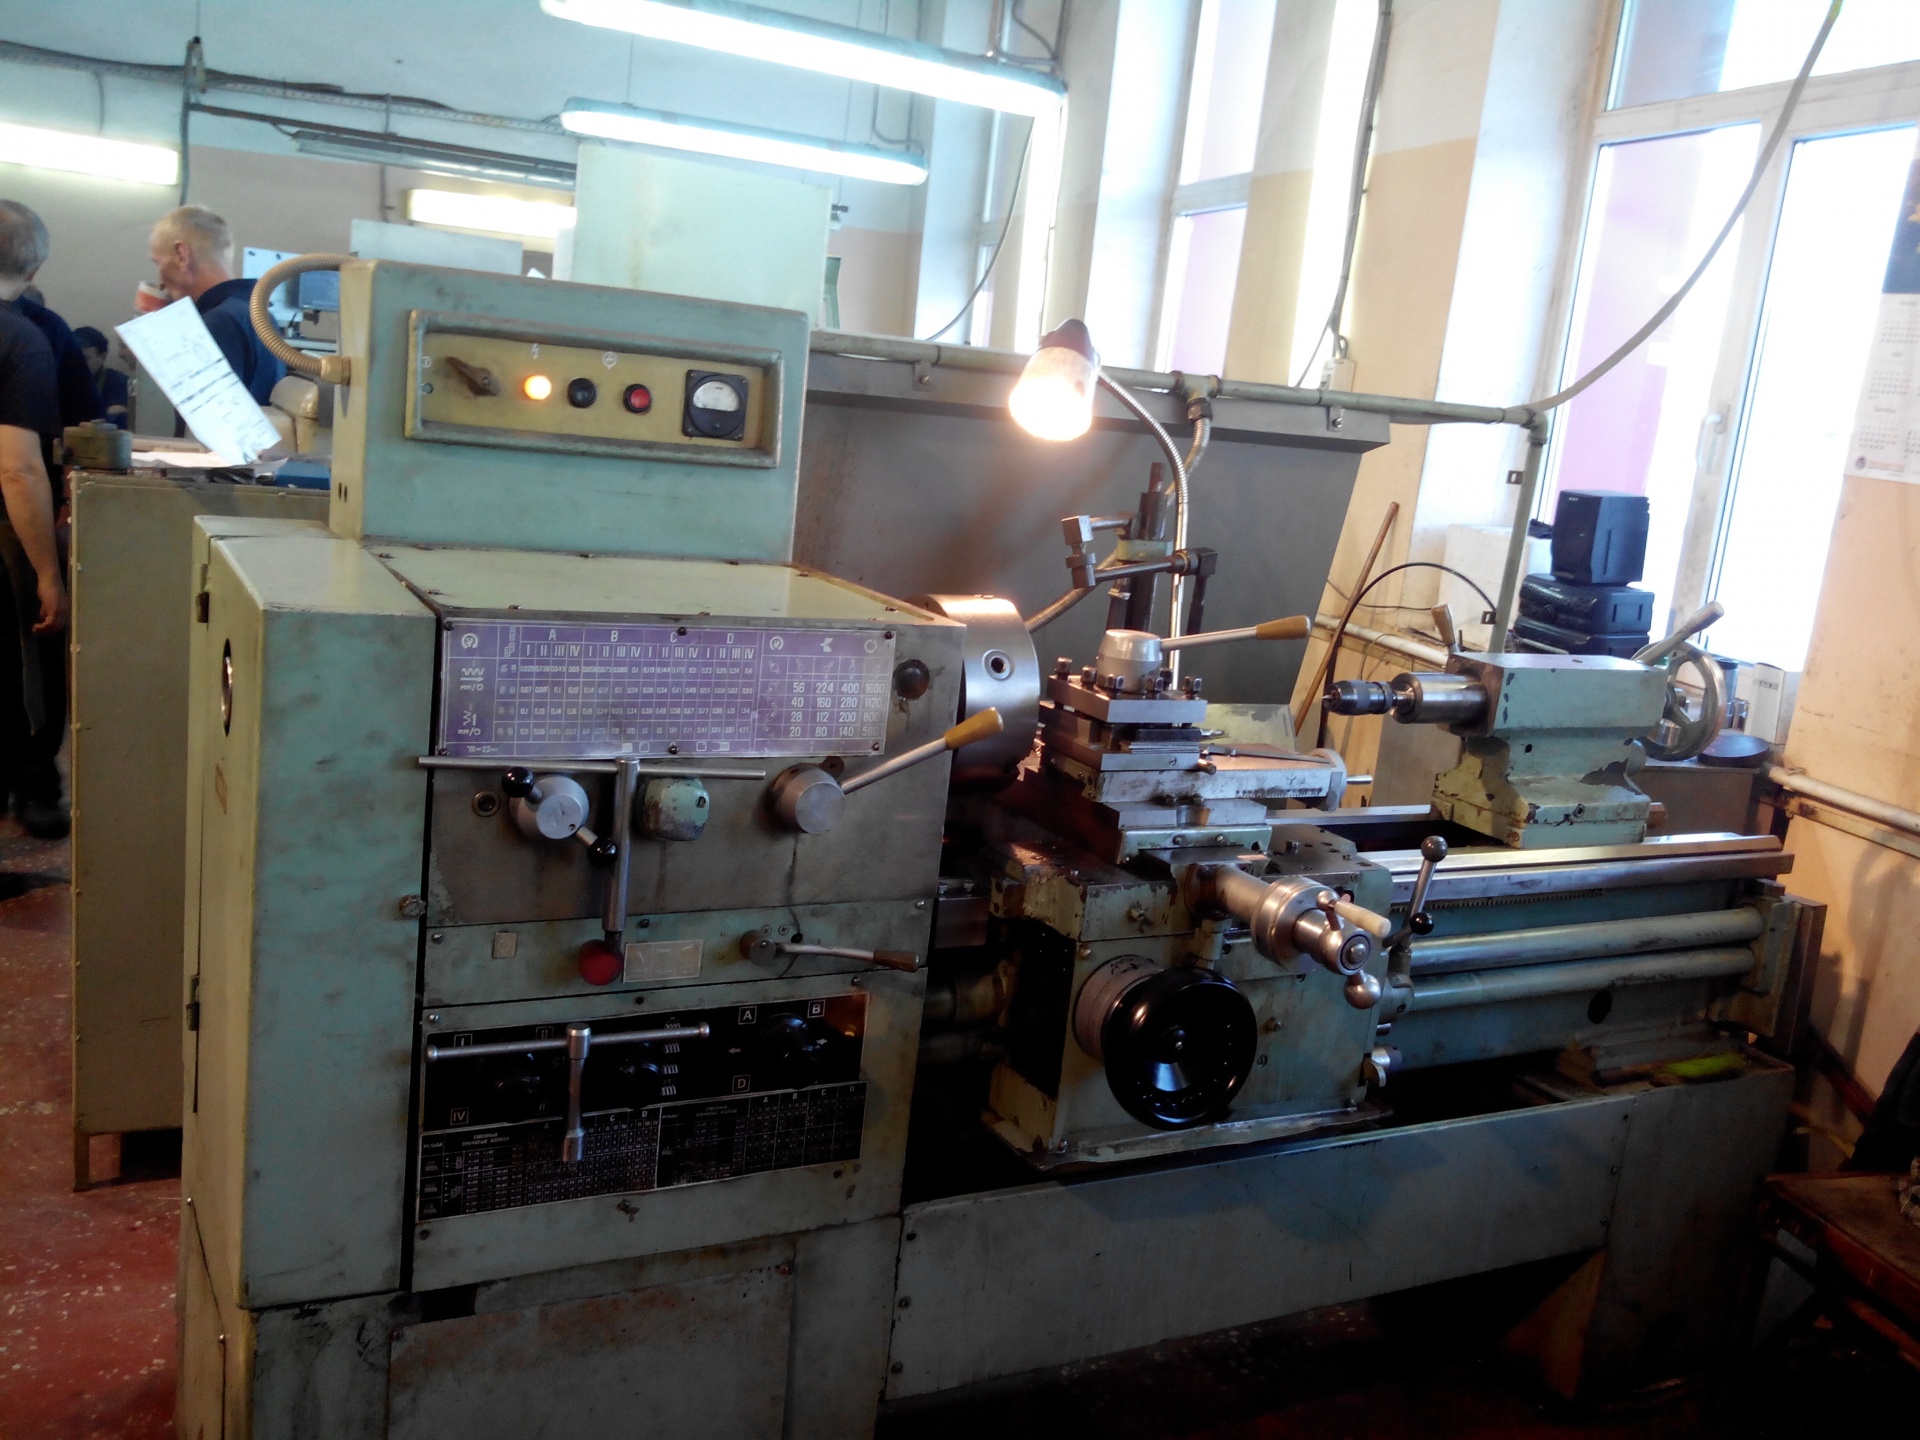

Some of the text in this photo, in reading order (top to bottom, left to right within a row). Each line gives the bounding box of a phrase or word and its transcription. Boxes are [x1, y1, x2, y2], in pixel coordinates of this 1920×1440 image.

[548, 629, 734, 645] A B C D
[540, 645, 547, 656] II
[554, 645, 565, 656] III
[569, 645, 580, 657] IV
[603, 646, 609, 657] II
[617, 646, 626, 658] III
[631, 646, 641, 658] IV
[662, 647, 669, 658] II
[674, 647, 684, 658] III
[688, 647, 699, 659] IV
[719, 648, 726, 659] II
[731, 648, 741, 659] III
[744, 648, 755, 659] IV
[793, 682, 885, 694] 56 224 400 1600
[790, 697, 882, 708] 40 160 280 1120
[790, 711, 879, 723] 28 112 200 800
[789, 726, 801, 737] 20
[815, 726, 828, 737] 80
[838, 726, 855, 737] 140
[742, 1004, 821, 1020] A B
[737, 1079, 747, 1089] D
[453, 1111, 466, 1122] IV
